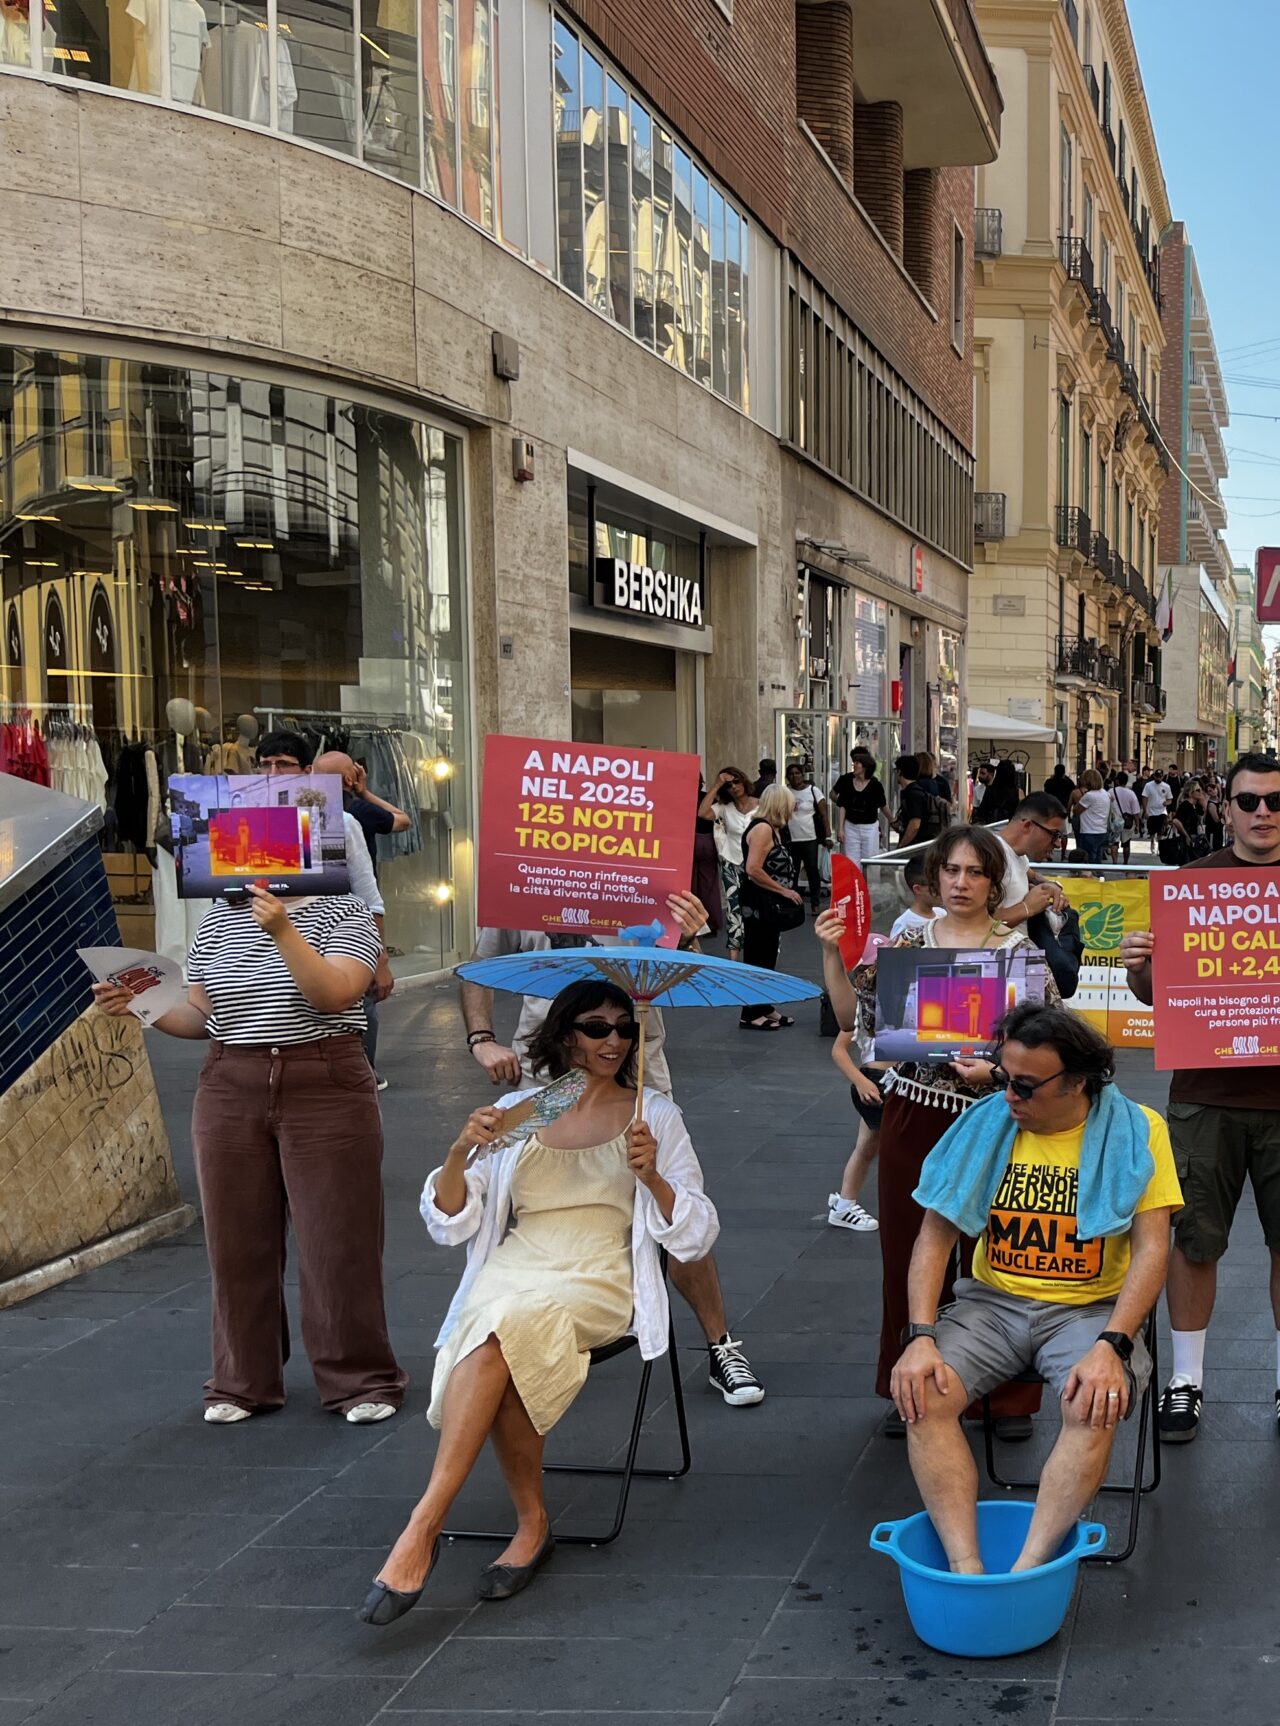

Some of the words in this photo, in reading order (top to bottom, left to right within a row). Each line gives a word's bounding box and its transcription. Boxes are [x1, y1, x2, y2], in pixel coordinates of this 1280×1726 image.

[614, 558, 703, 625] BERSHKA
[524, 750, 545, 771] A
[552, 752, 654, 782] NAPOLI
[521, 776, 574, 800] NEL
[580, 782, 654, 811] 2025,
[518, 802, 564, 825] 125
[573, 807, 653, 833] NOTTI
[514, 827, 660, 859] TROPICALI
[518, 863, 567, 877] Quando
[569, 868, 592, 879] non
[595, 871, 649, 885] rinfresca
[509, 882, 520, 893] la
[523, 883, 551, 897] città
[553, 887, 599, 900] diventa
[602, 890, 658, 906] invivibile.
[527, 876, 587, 889] nemmeno
[589, 878, 601, 891] di
[604, 883, 640, 896] notte,
[1163, 883, 1205, 901] DAL
[1208, 881, 1260, 899] 1960
[1264, 881, 1280, 898] A
[542, 914, 561, 923] CHE
[561, 907, 590, 925] CALDO
[590, 917, 609, 927] CHE
[611, 919, 626, 928] FA.
[1183, 926, 1225, 952] PIÙ
[1079, 956, 1124, 969] MBIE
[1197, 957, 1223, 978] DI
[1168, 996, 1202, 1008] Napoli
[1204, 996, 1217, 1006] ha
[1219, 995, 1259, 1009] bisogno
[1261, 994, 1271, 1004] di
[1194, 1007, 1218, 1017] cura
[1219, 1008, 1226, 1017] e
[1134, 1029, 1155, 1037] CAL
[1209, 1018, 1250, 1029] persone
[1252, 1016, 1268, 1028] più
[1214, 1047, 1233, 1056] CHE
[1233, 1035, 1259, 1055] CALDO
[1259, 1045, 1278, 1055] CHE
[1032, 1163, 1061, 1178] MILE
[990, 1214, 1058, 1254] MAI
[990, 1247, 1092, 1274] NUCLEARE.
